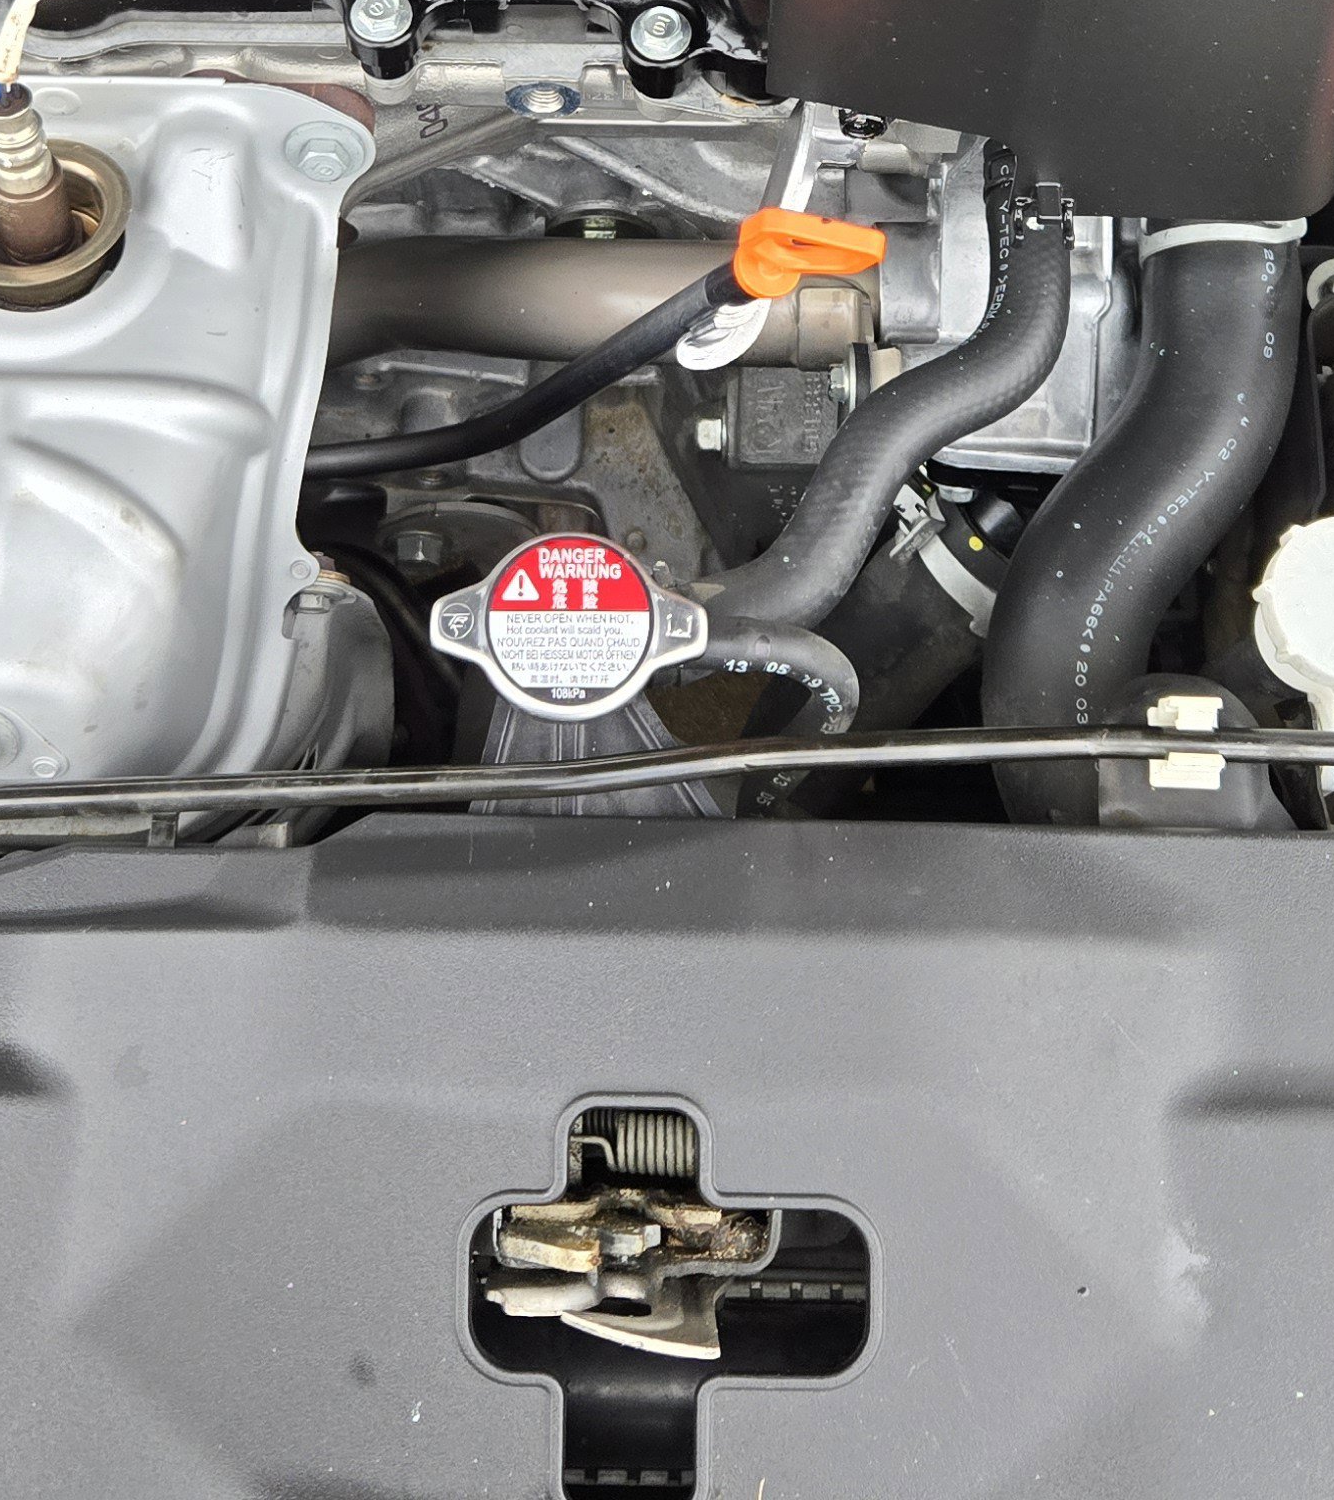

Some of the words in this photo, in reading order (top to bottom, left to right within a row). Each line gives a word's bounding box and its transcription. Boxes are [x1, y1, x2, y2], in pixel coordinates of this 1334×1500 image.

[538, 547, 606, 564] DANGER
[538, 563, 622, 580] WARNUNG
[506, 613, 542, 624] NEVER
[544, 613, 573, 624] OPEN
[576, 613, 607, 624] WHEN
[506, 625, 522, 635] Hot
[524, 625, 559, 635] coolant
[560, 625, 576, 635] will
[577, 625, 601, 635] scald
[497, 637, 546, 648] N'OUVREZ
[547, 637, 567, 648] PAS
[569, 637, 605, 648] QUAND
[501, 649, 525, 660] NICHT
[575, 649, 605, 660] MOTOR
[550, 687, 587, 700] 108kPa
[819, 686, 844, 714] TPC
